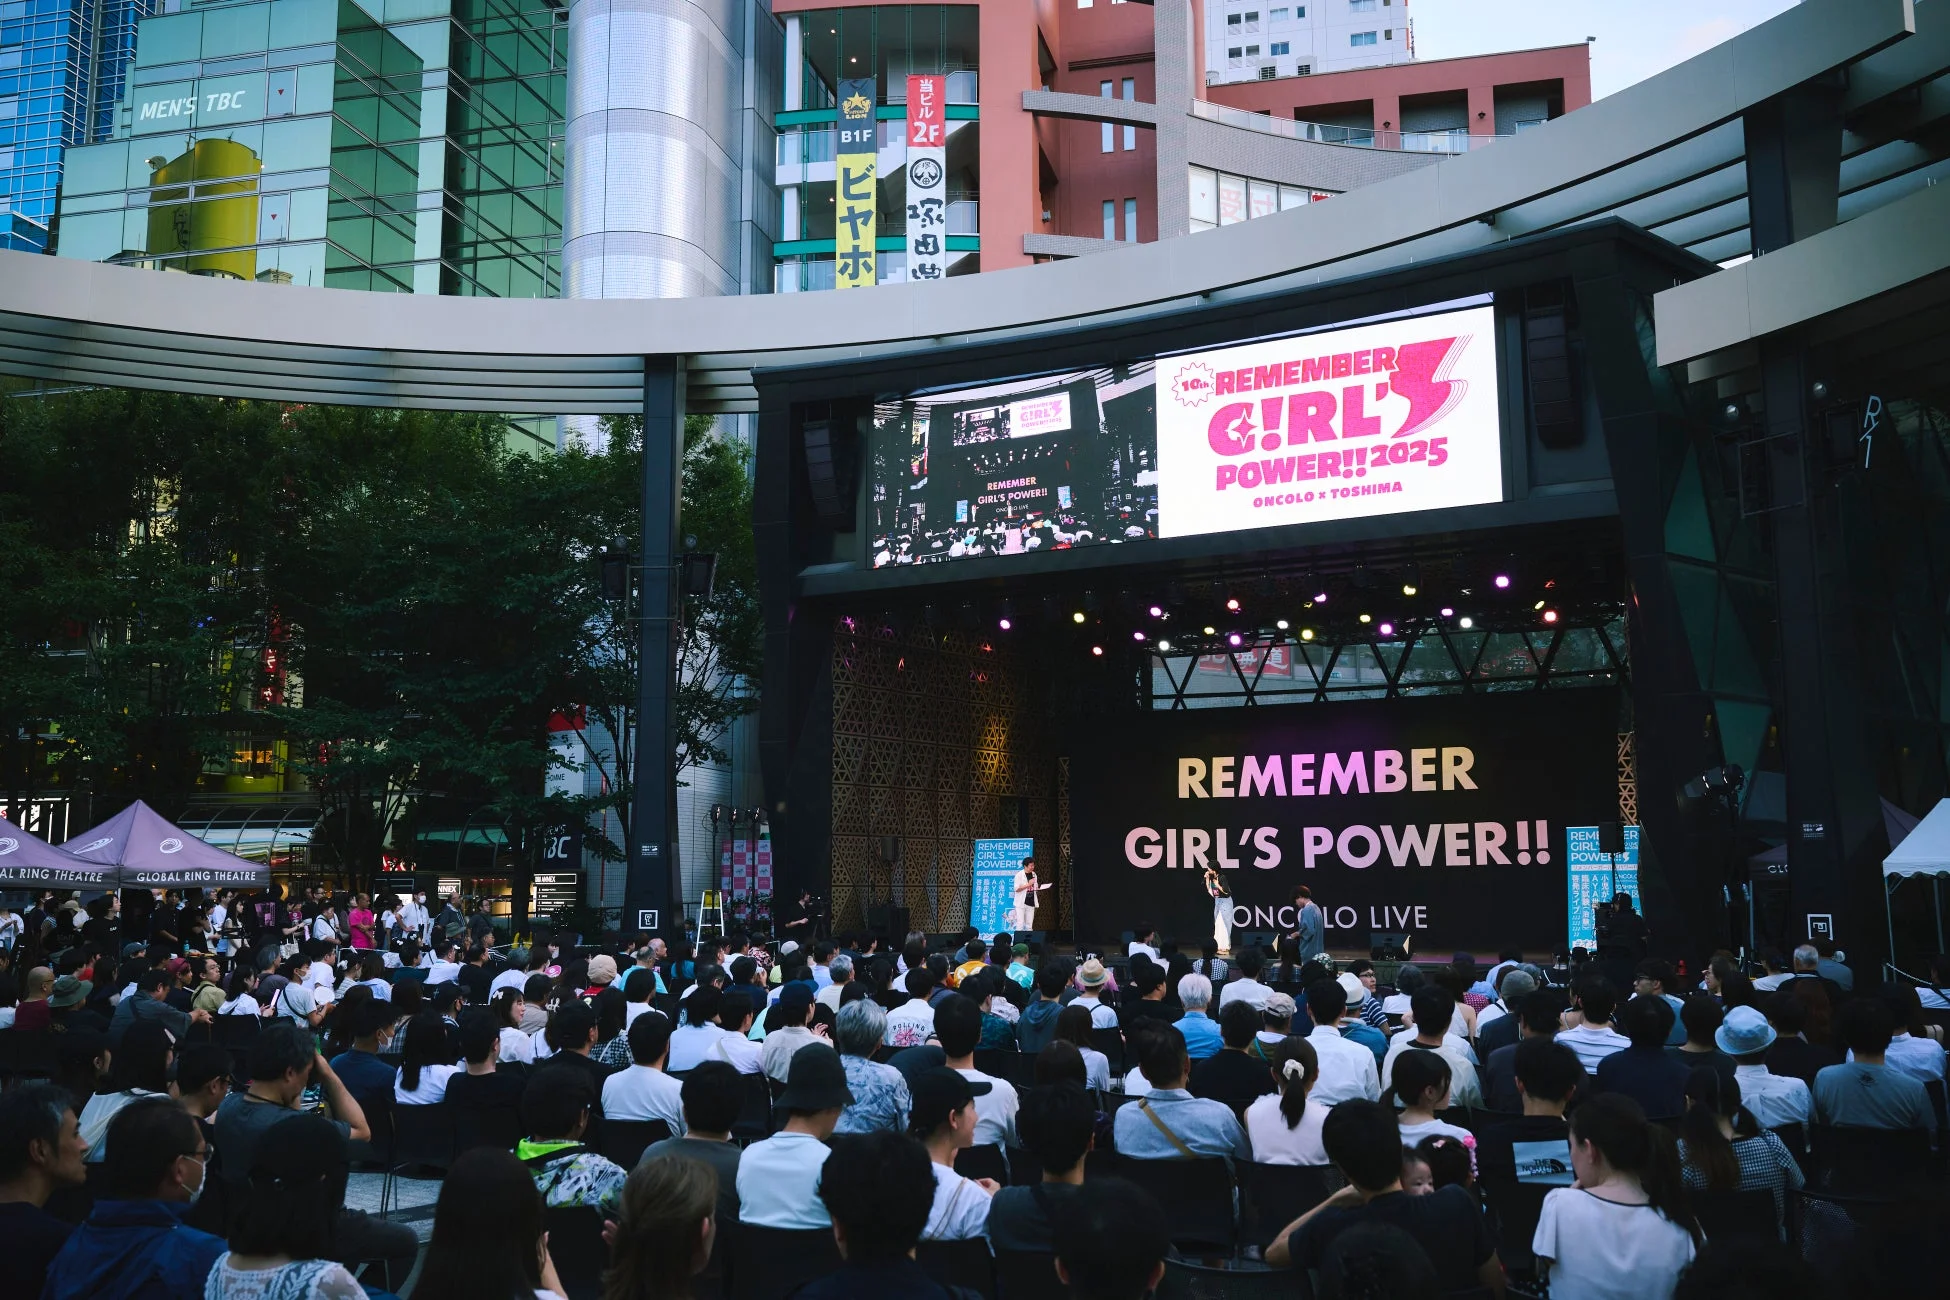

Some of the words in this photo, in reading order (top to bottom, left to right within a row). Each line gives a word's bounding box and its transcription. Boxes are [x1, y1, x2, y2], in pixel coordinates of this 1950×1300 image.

[139, 96, 197, 121] MEN'S
[206, 90, 246, 112] TBC
[918, 78, 934, 119] 当ビル
[841, 129, 873, 143] B1F
[912, 121, 940, 143] 2F
[838, 163, 875, 287] ビヤホ
[1215, 346, 1400, 395] REMEMBER
[1181, 377, 1210, 393] 10th
[1216, 447, 1368, 491] POWER!!
[1370, 437, 1449, 468] 2025
[987, 476, 1037, 491] REMEMBER
[977, 493, 1006, 505] GIRL'S
[1008, 488, 1048, 501] POWER!!
[1252, 491, 1315, 508] ONCOLO
[1330, 481, 1403, 499] TOSHIMA
[1178, 746, 1478, 798] REMEMBER
[1124, 826, 1282, 869] GIRL'S
[1303, 819, 1551, 868] POWER!!
[1570, 830, 1639, 840] REMEER
[543, 836, 572, 858] BC
[977, 851, 1005, 860] GIRL'S
[978, 842, 1031, 851] REMEMBER
[1570, 841, 1600, 851] GIRL'
[977, 860, 1017, 869] POWER!!
[19, 869, 50, 880] RING
[54, 870, 104, 883] THEATRE
[137, 872, 181, 883] GLOBAL
[184, 872, 211, 881] RING
[214, 871, 256, 881] THEATRE
[1232, 905, 1357, 929] ONCLO
[1370, 905, 1428, 929] LIVE
